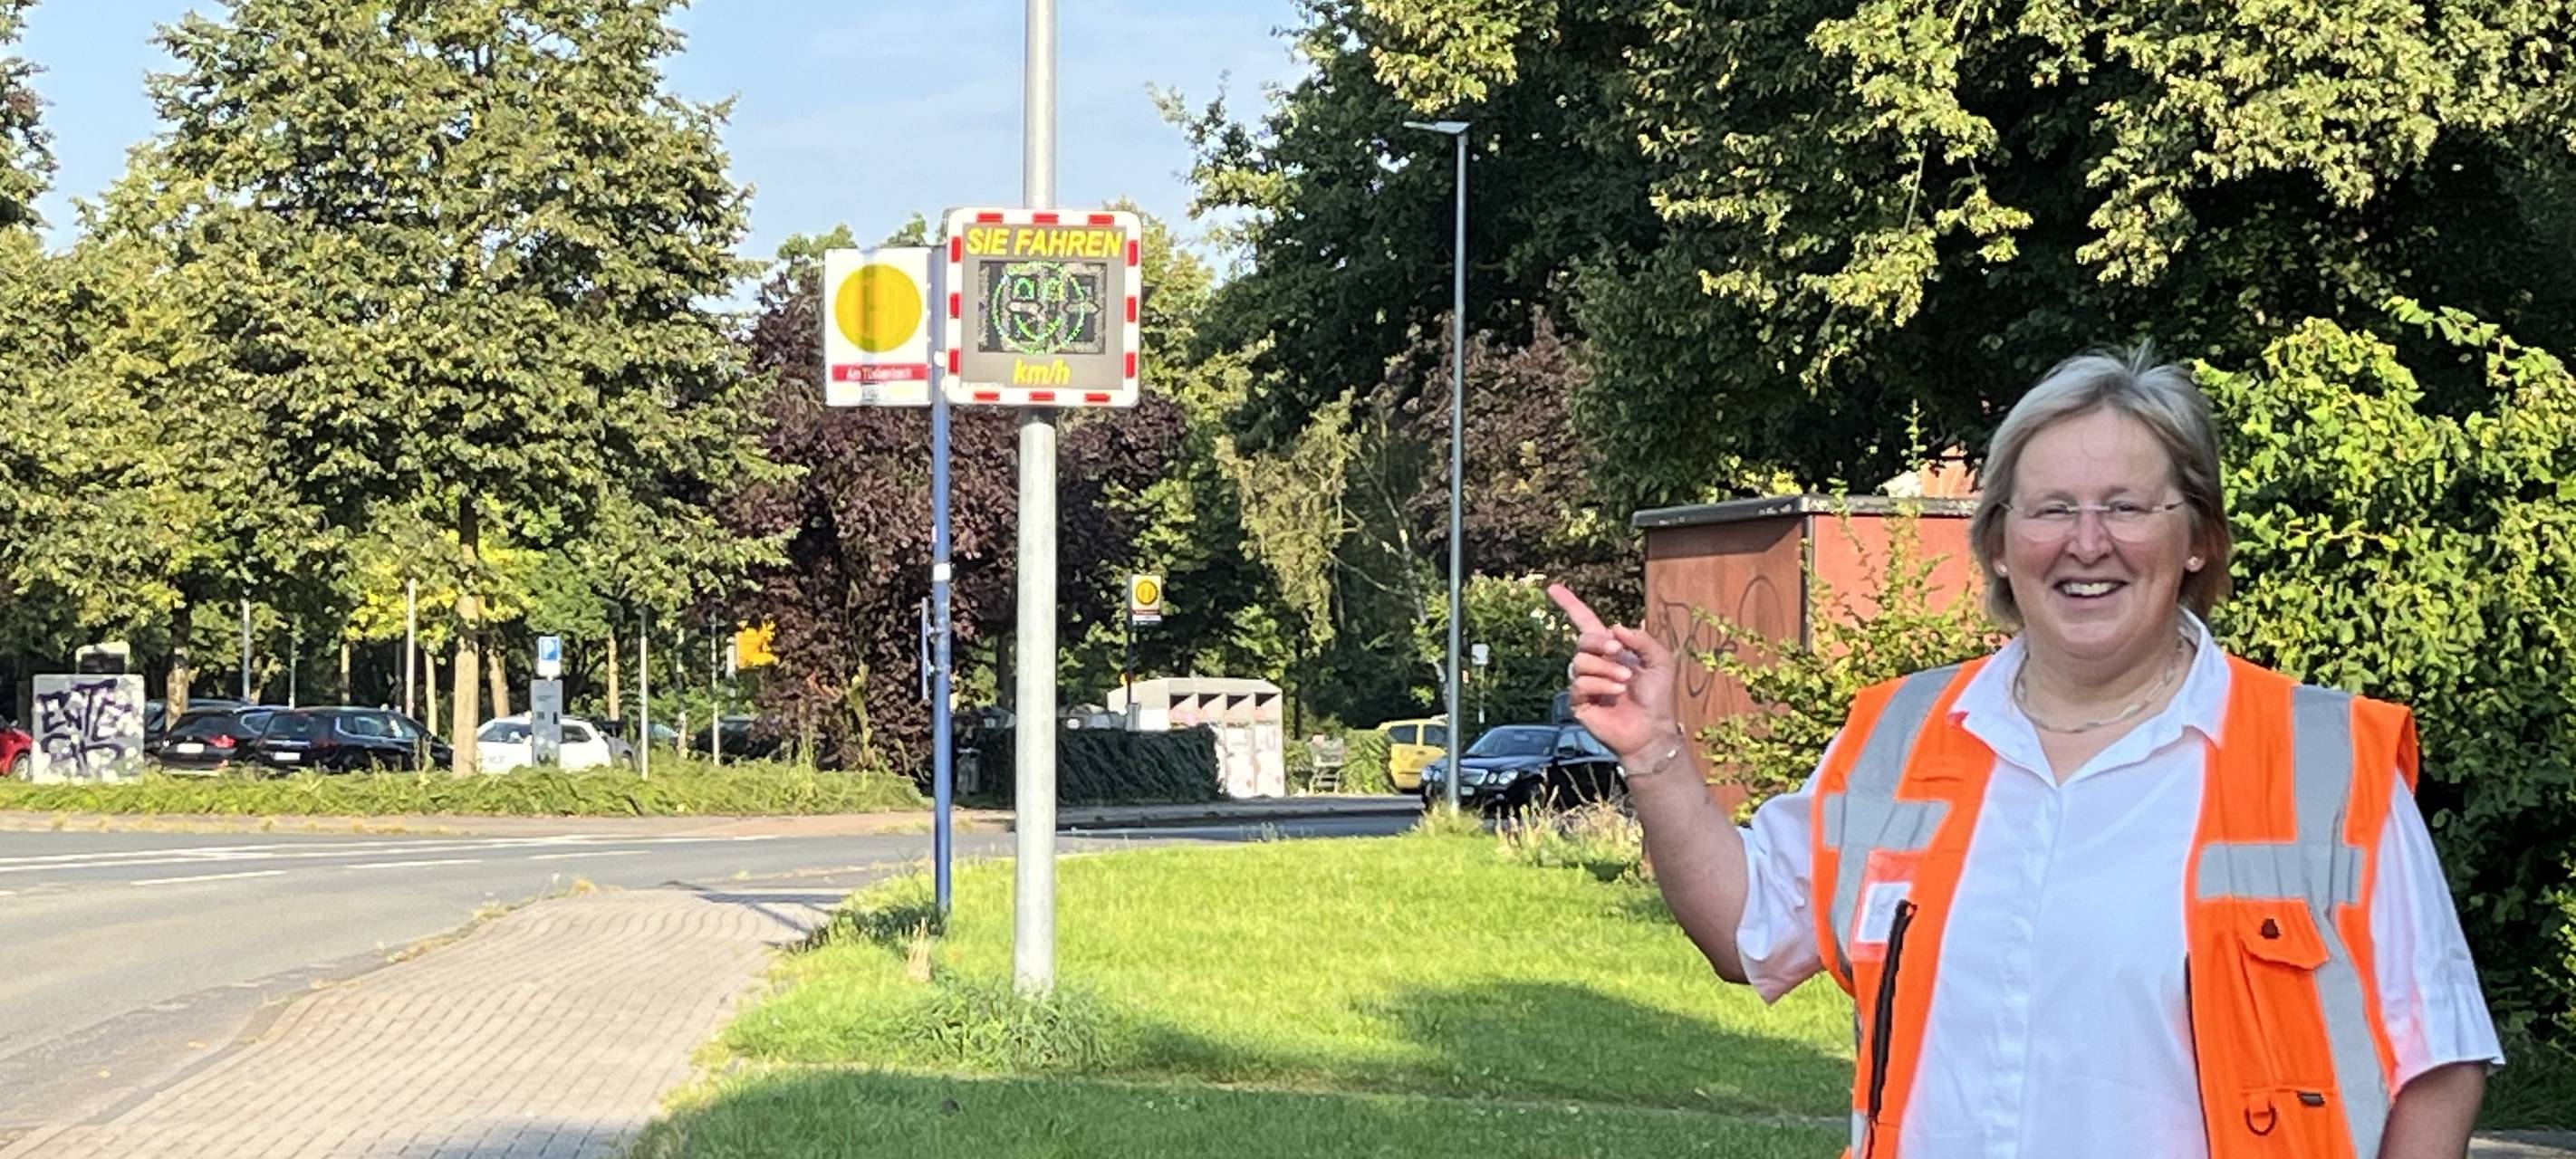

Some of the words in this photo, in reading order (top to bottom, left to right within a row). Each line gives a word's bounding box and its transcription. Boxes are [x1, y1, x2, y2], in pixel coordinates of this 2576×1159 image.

[966, 227, 1010, 255] SIE
[1014, 228, 1123, 258] FAHREN
[1013, 359, 1071, 385] km/h
